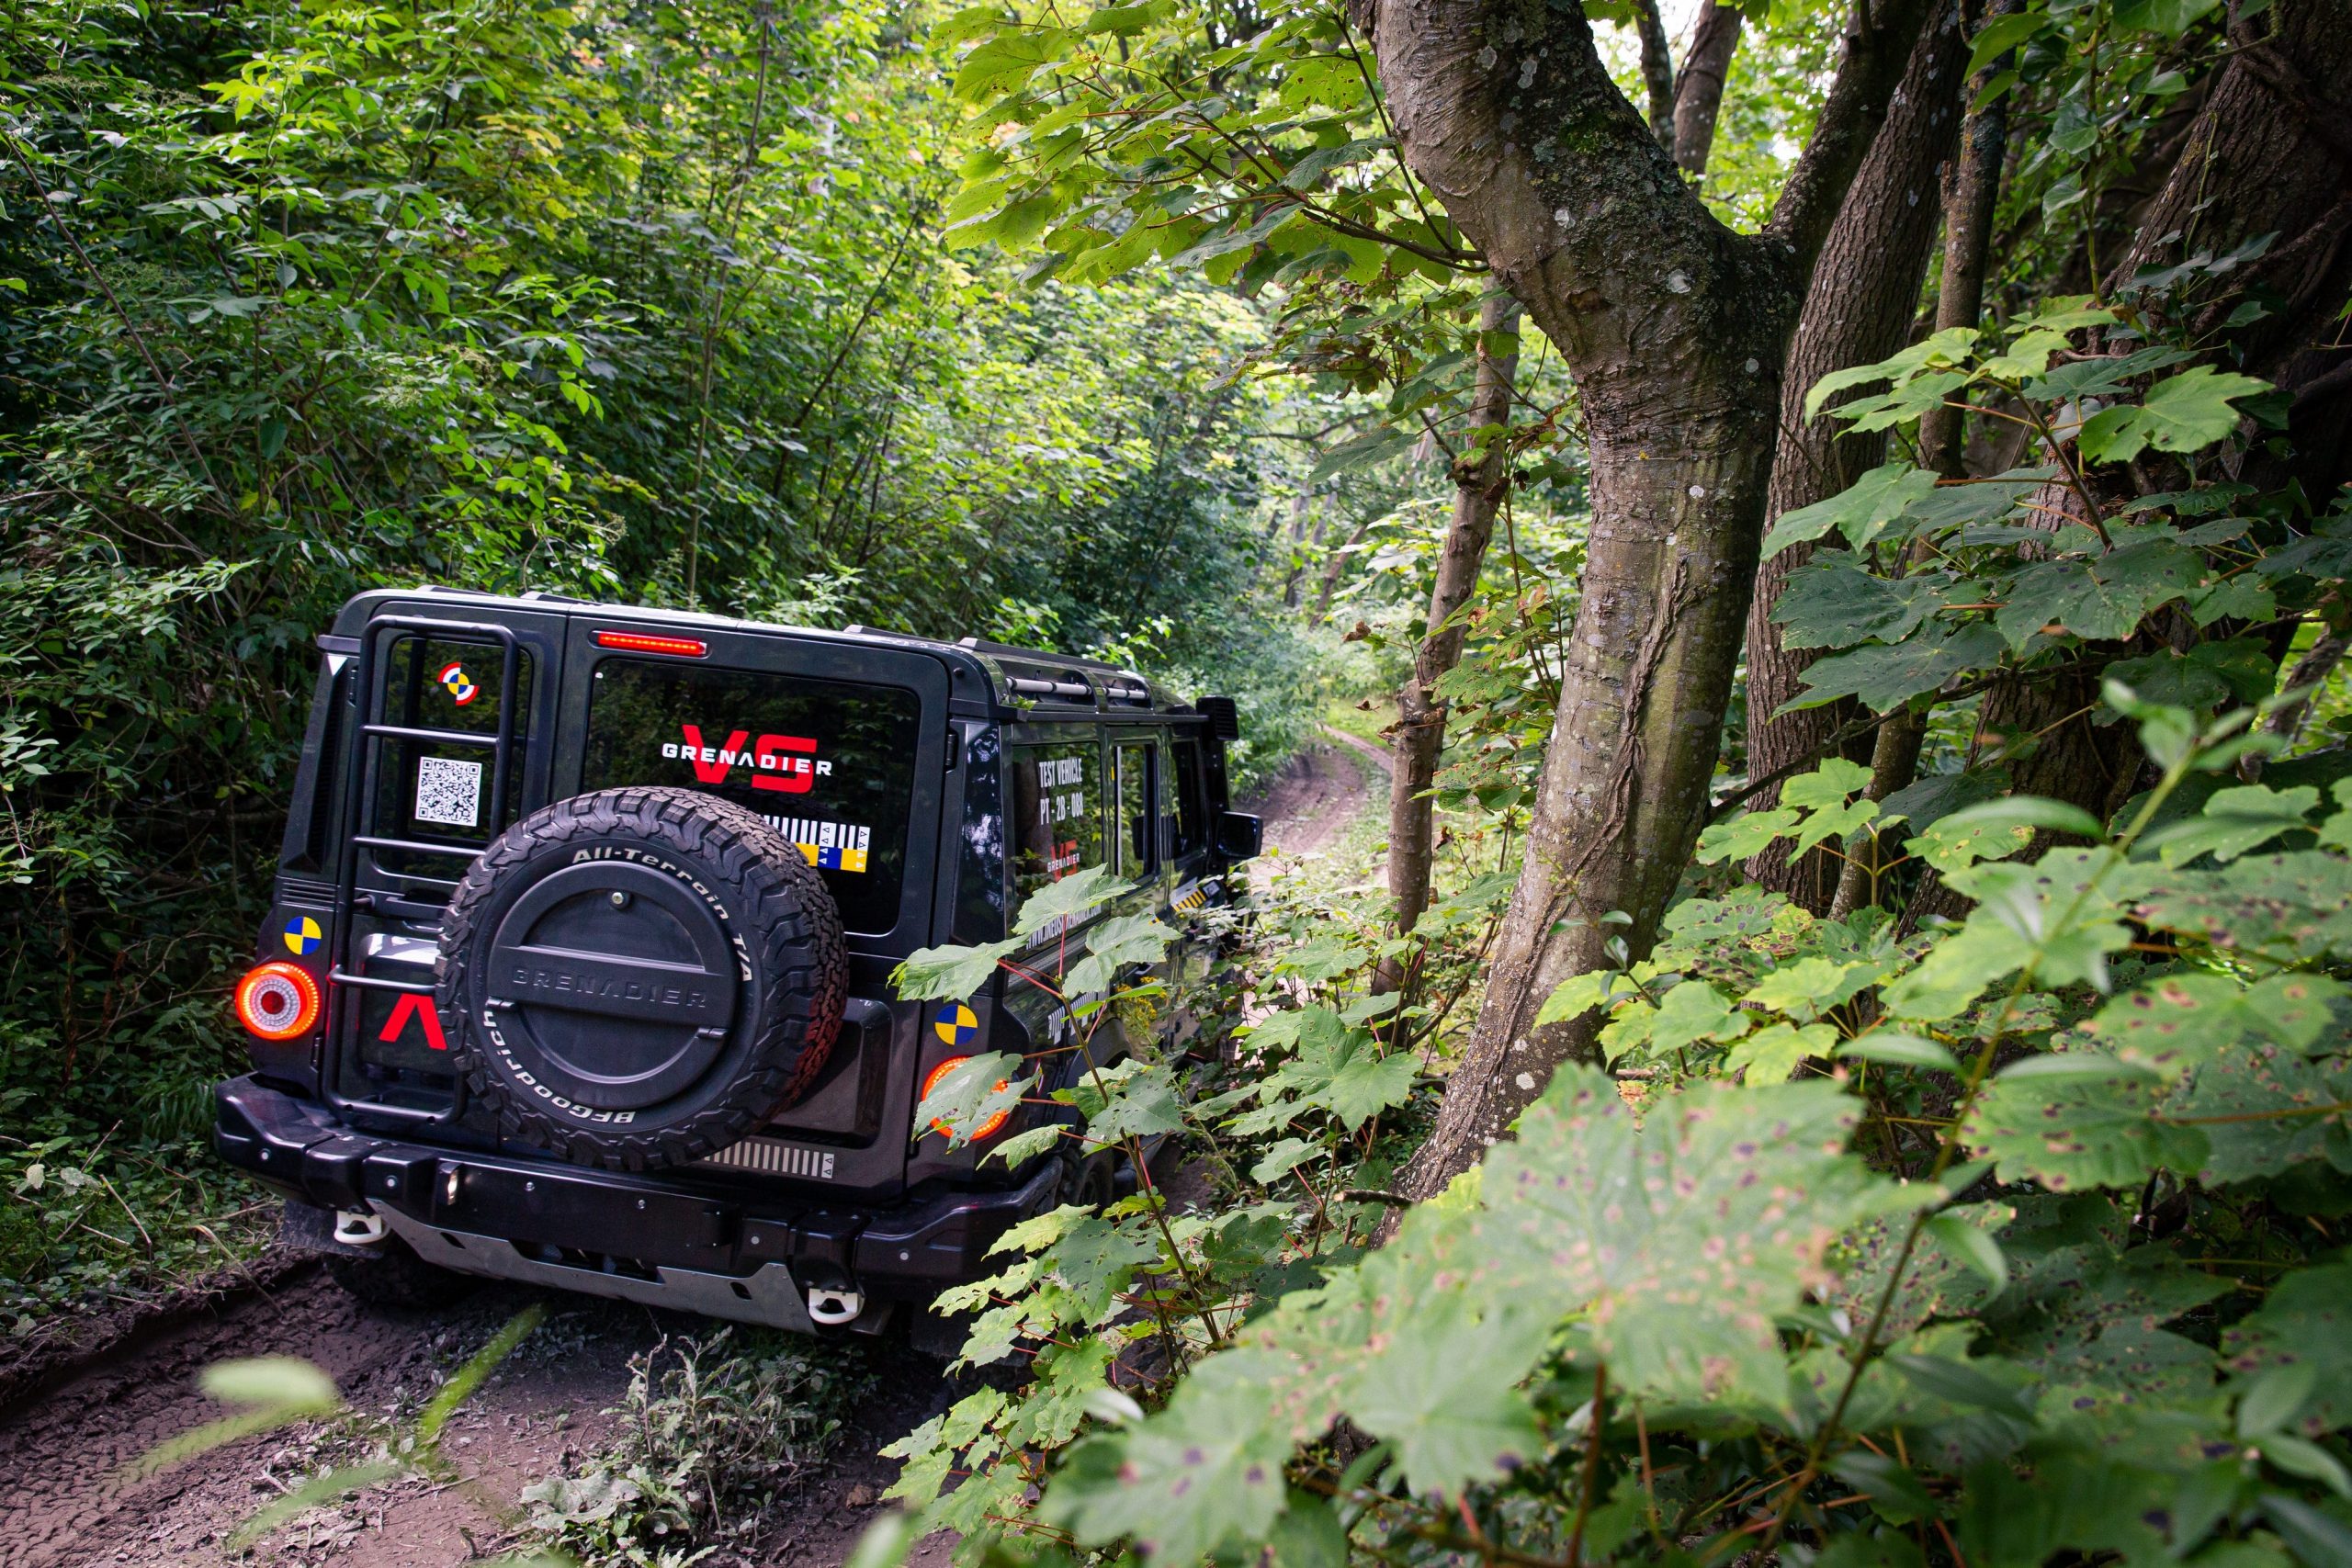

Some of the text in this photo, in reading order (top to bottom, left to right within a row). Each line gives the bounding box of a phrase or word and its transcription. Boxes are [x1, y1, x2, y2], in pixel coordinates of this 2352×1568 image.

[662, 743, 832, 776] GRENADIER
[682, 724, 818, 794] VS
[1039, 758, 1082, 788] TEST VEHICLE
[1040, 797, 1049, 825] PT
[1047, 852, 1080, 872] GRENADIER
[571, 847, 752, 981] All-Terrain T/A
[513, 966, 707, 1008] GRENADIER
[483, 1011, 636, 1123] BFGoodrich
